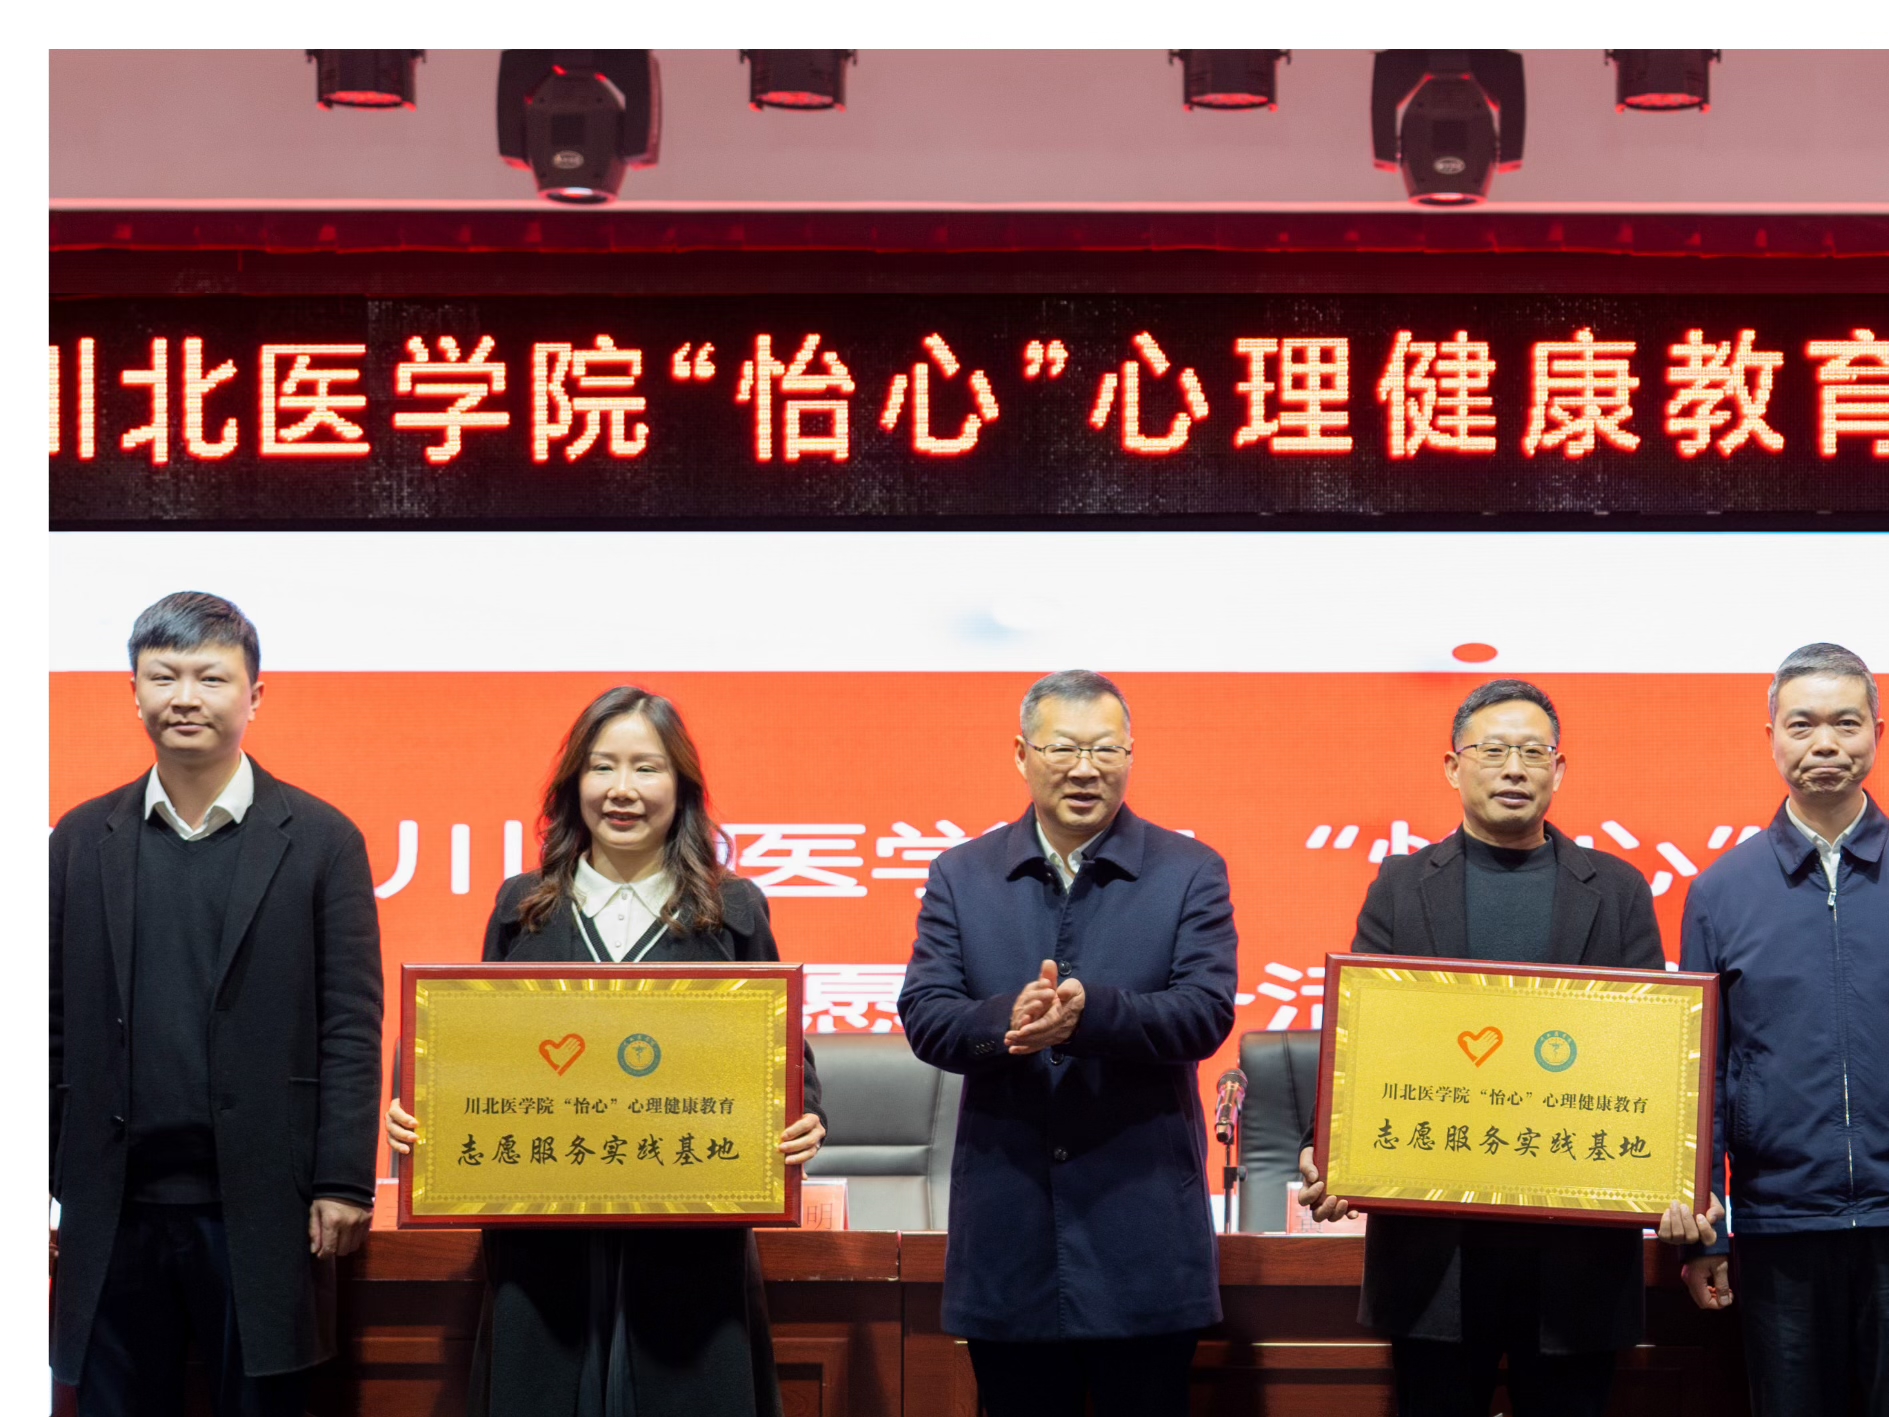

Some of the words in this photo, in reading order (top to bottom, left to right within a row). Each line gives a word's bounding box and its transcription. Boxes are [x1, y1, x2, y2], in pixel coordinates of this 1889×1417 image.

[464, 1096, 735, 1116] 川北医学院“怡心”心理健康教育
[1381, 1082, 1649, 1115] 川北医学院“怡心”心理健康教育
[457, 1132, 740, 1167] 志愿服务实践基地
[1373, 1118, 1652, 1162] 志愿服务实践基地
